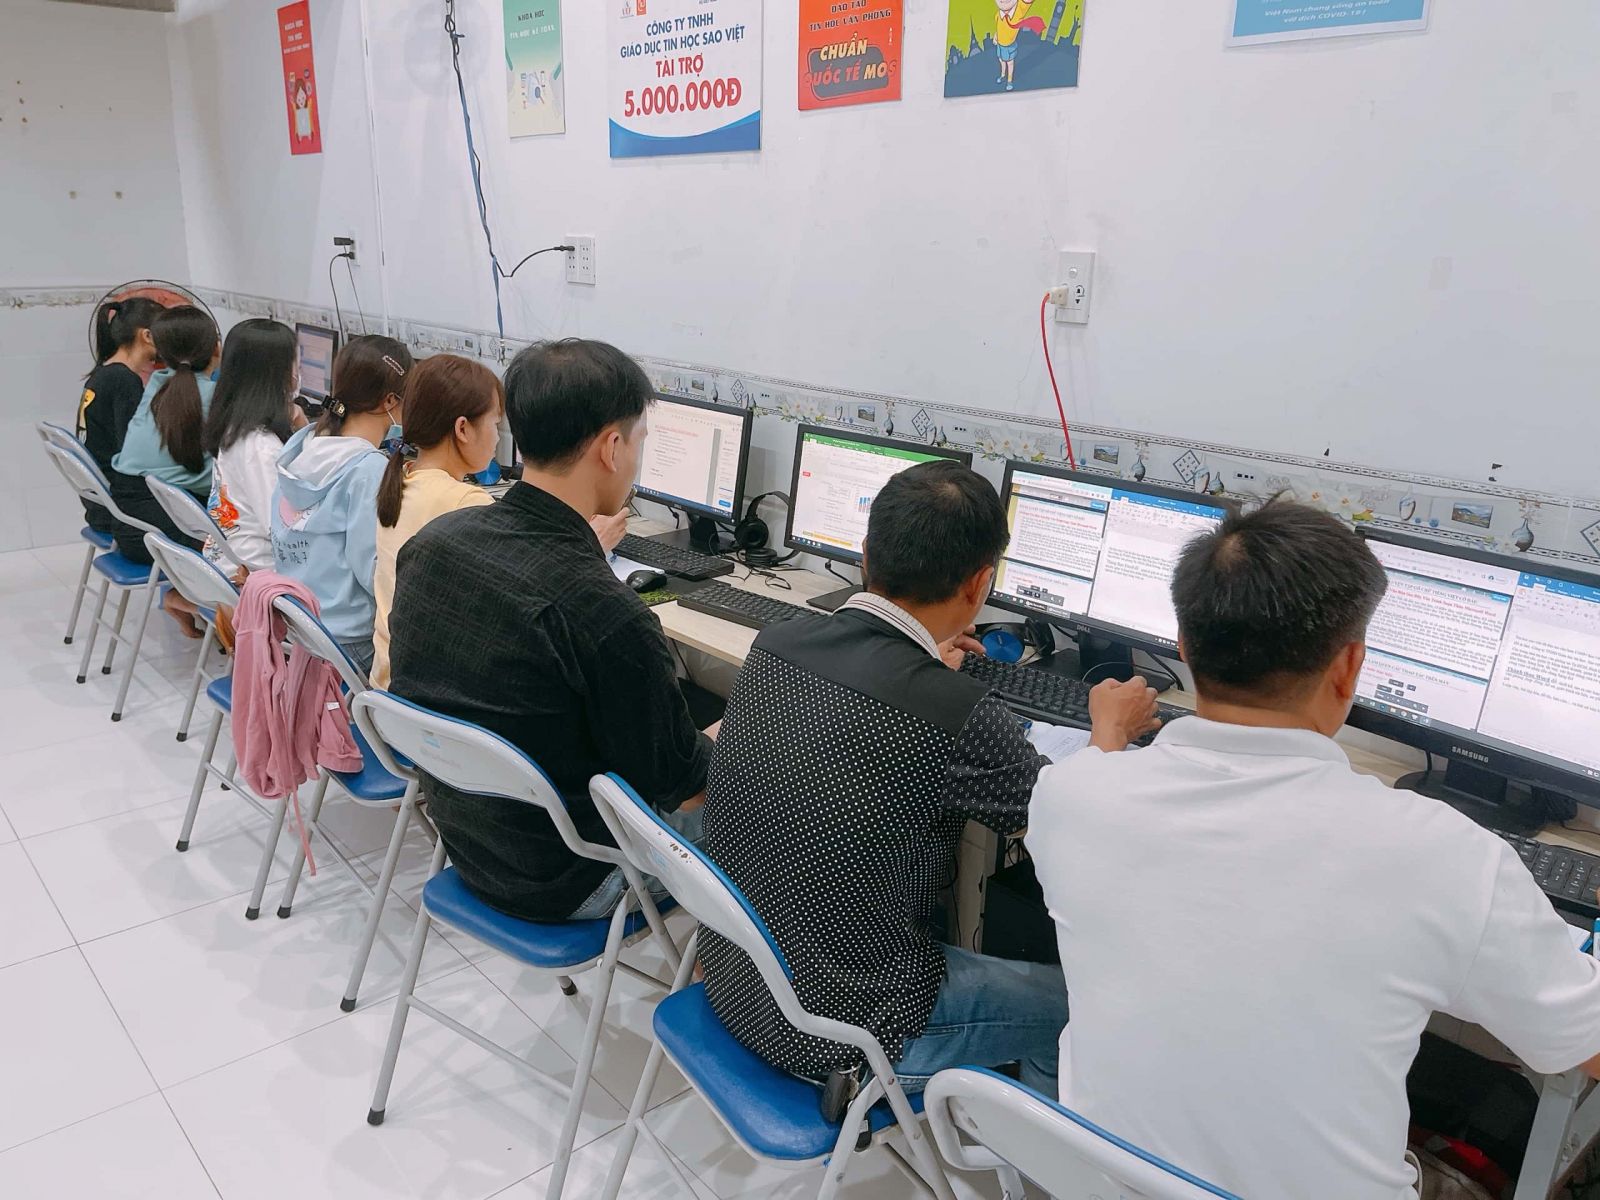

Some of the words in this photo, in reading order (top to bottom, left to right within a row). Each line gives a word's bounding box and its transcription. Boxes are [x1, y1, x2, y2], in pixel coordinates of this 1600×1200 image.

[646, 20, 672, 37] CÔNG
[675, 17, 686, 32] TY
[688, 12, 714, 30] TNHH
[620, 42, 642, 58] GIÁO
[644, 40, 661, 57] DỤC
[663, 37, 678, 52] TIN
[680, 34, 700, 51] HỌC
[702, 29, 723, 45] SAO
[725, 23, 745, 43] VIỆT
[819, 32, 869, 61] CHUẨN
[655, 55, 675, 79] TÀI
[678, 52, 704, 78] TRỢ
[845, 60, 862, 82] TẾ
[863, 59, 897, 81] MOS
[623, 77, 742, 118] 5.000.000Đ
[1451, 745, 1489, 763] SAMSUNG
